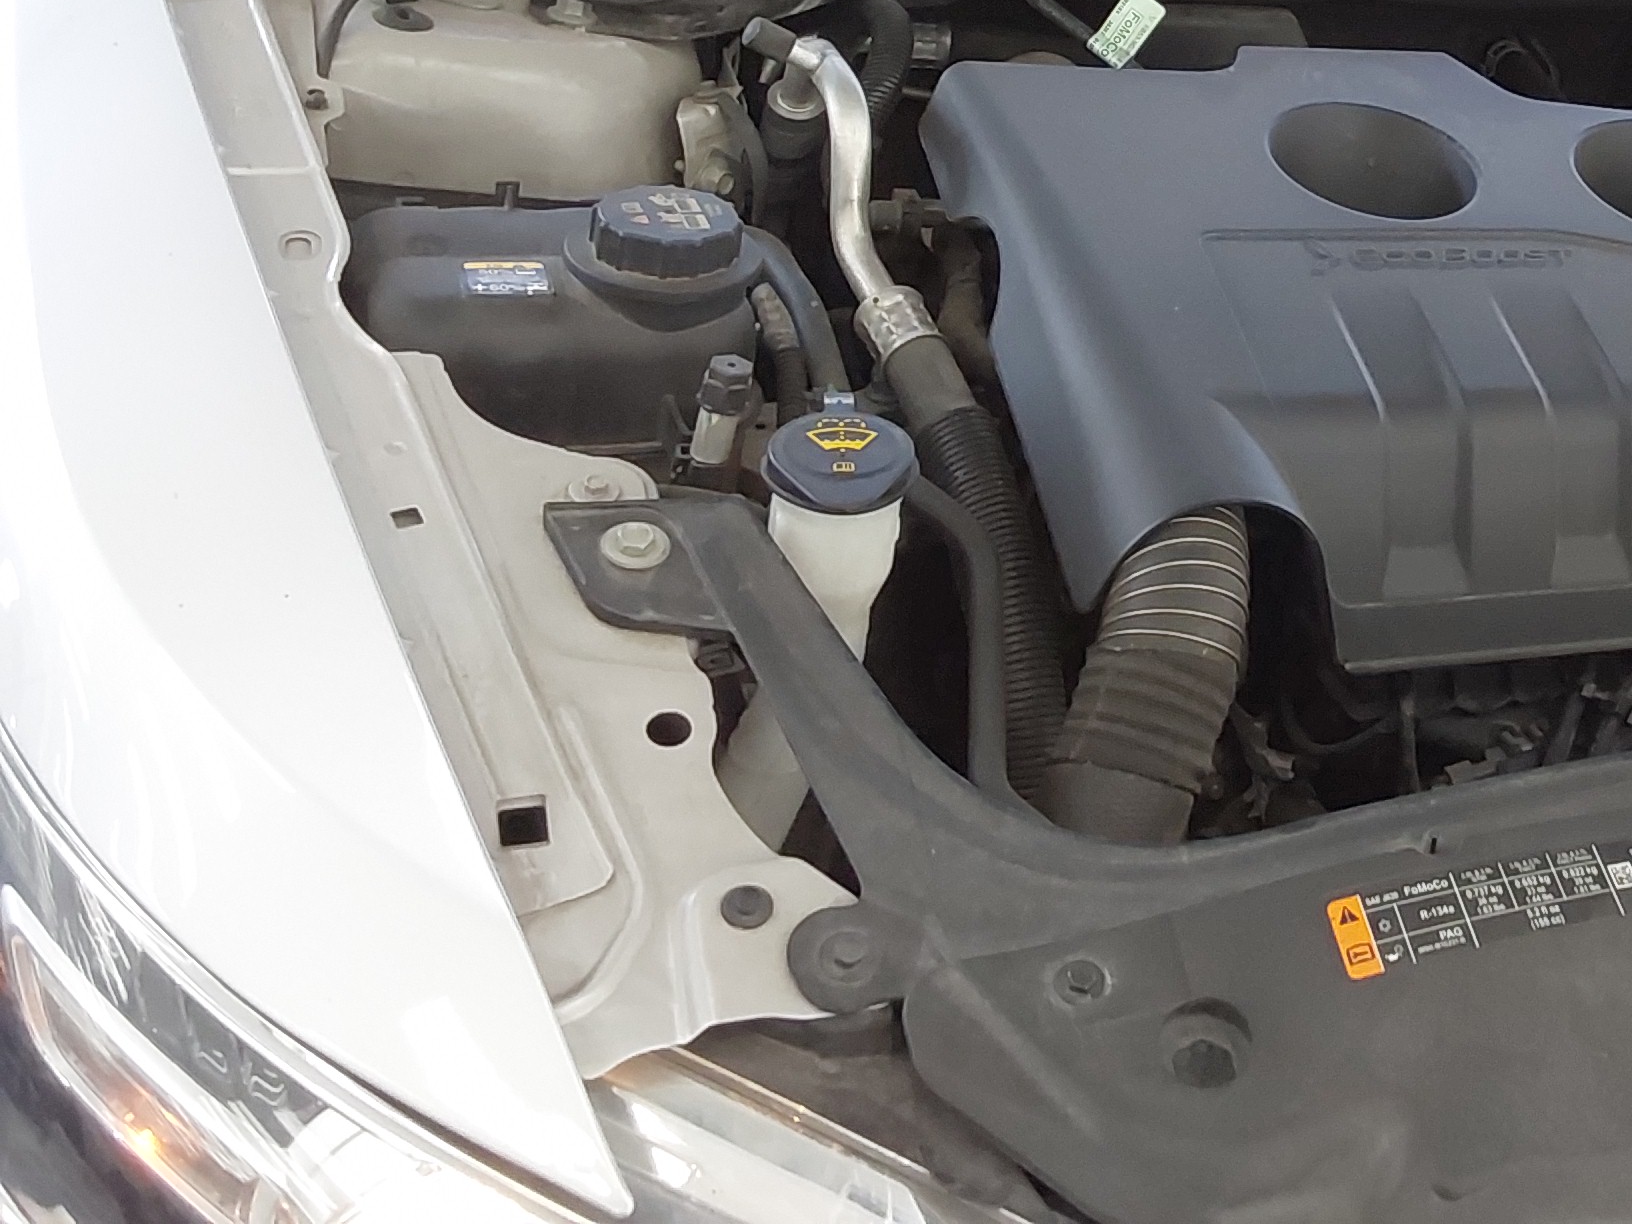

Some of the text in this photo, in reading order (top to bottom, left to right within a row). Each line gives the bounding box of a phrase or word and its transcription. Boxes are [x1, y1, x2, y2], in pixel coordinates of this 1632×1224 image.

[1101, 11, 1141, 57] FoMoCo
[1403, 878, 1449, 897] FoMoCo
[1537, 874, 1551, 885] kg
[1490, 884, 1504, 895] kg
[1420, 904, 1455, 921] R-134a
